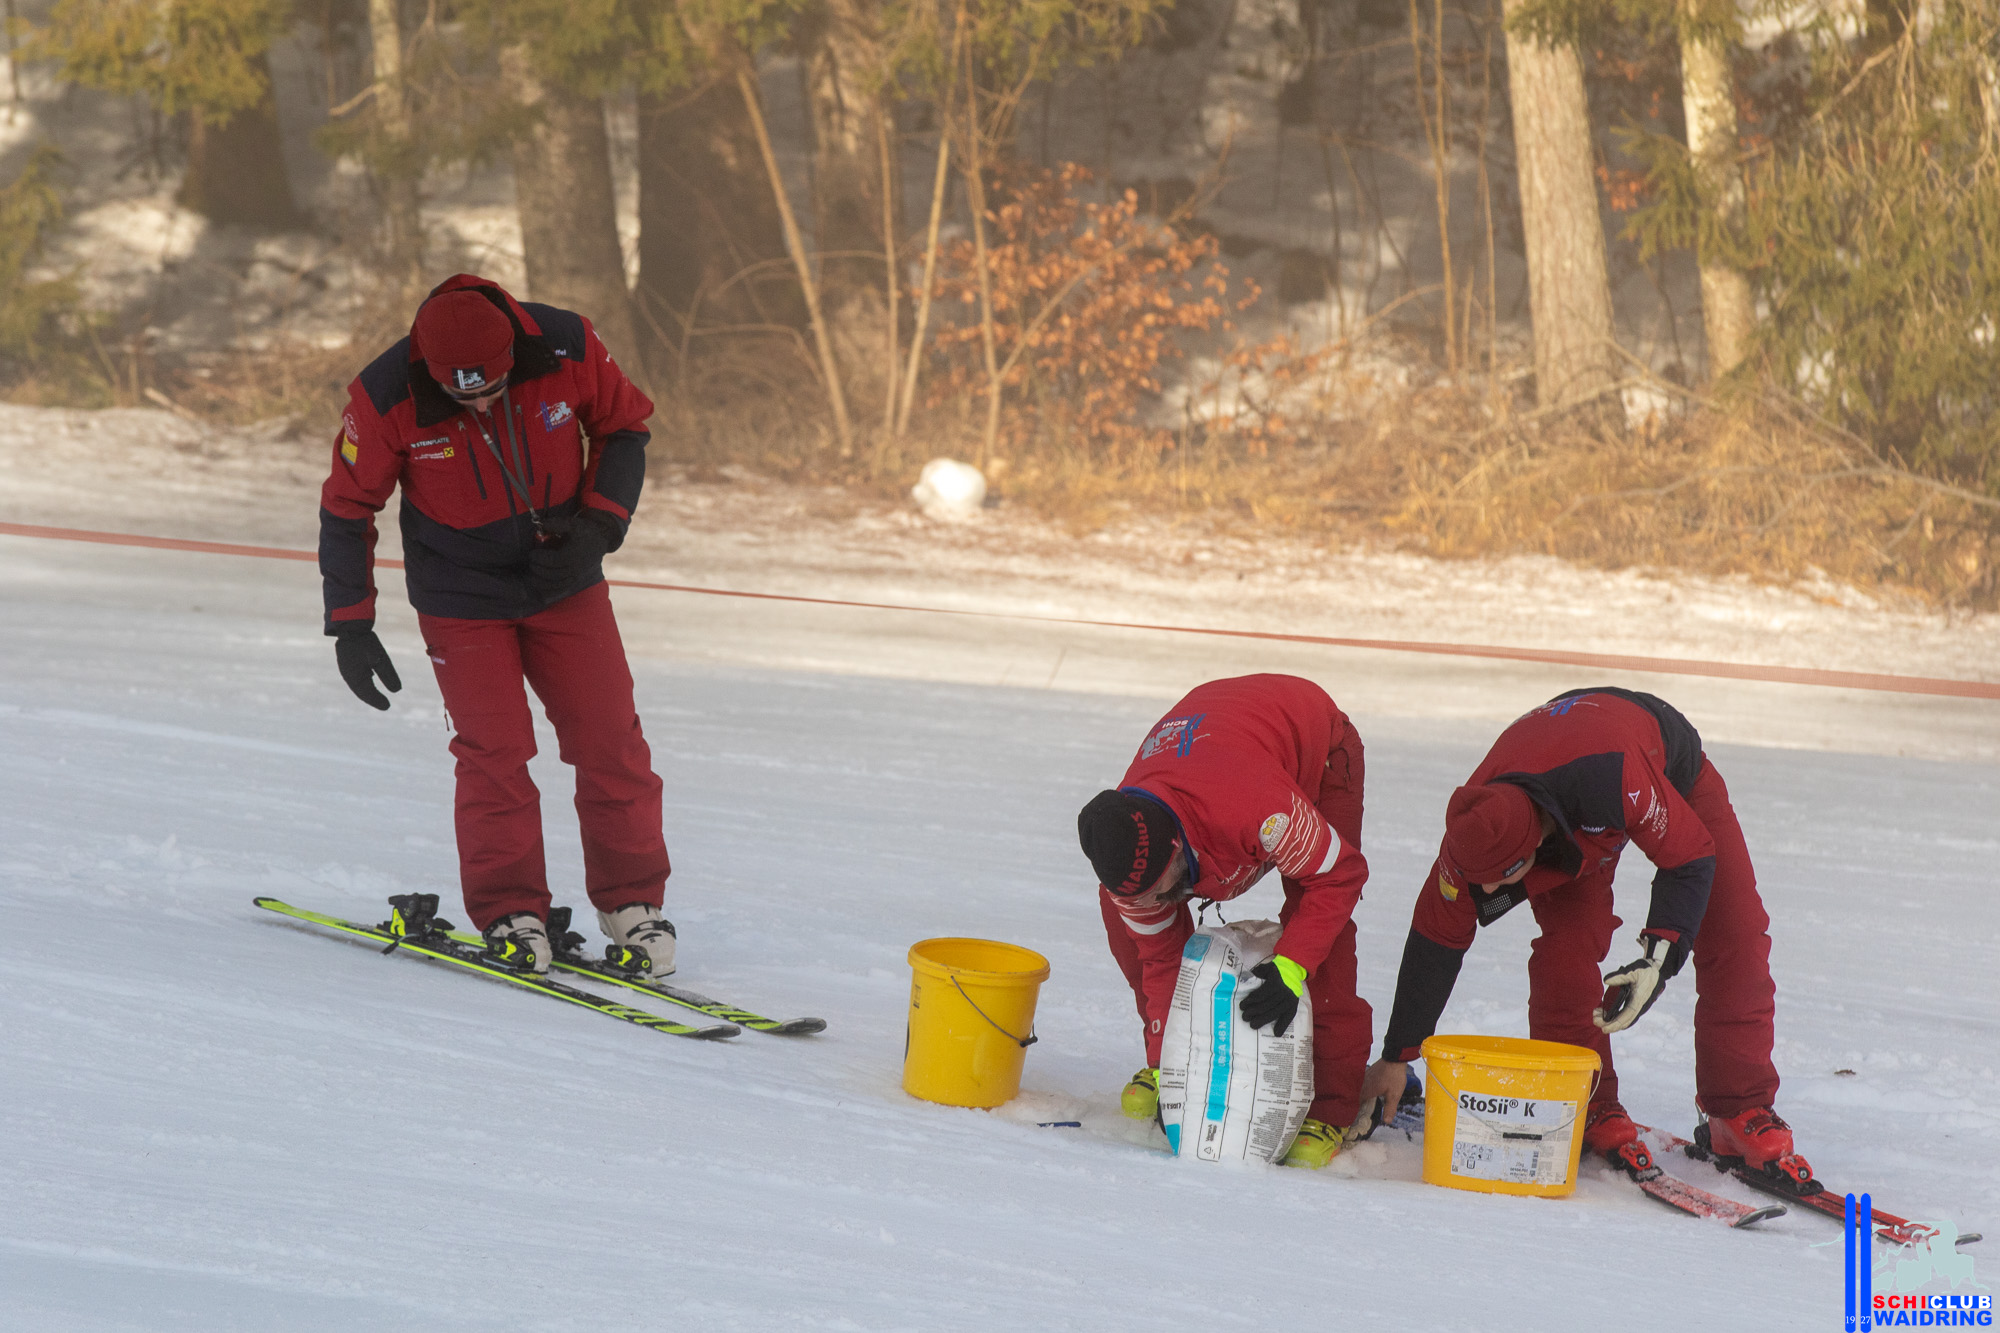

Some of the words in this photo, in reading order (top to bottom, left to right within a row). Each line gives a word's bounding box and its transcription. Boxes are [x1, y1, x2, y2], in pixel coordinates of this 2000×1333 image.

[416, 437, 450, 448] STEINPLATTE
[1162, 719, 1189, 729] SCHI
[1117, 811, 1151, 896] MADSHUS
[1226, 950, 1235, 968] LAT
[1524, 1101, 1537, 1118] K
